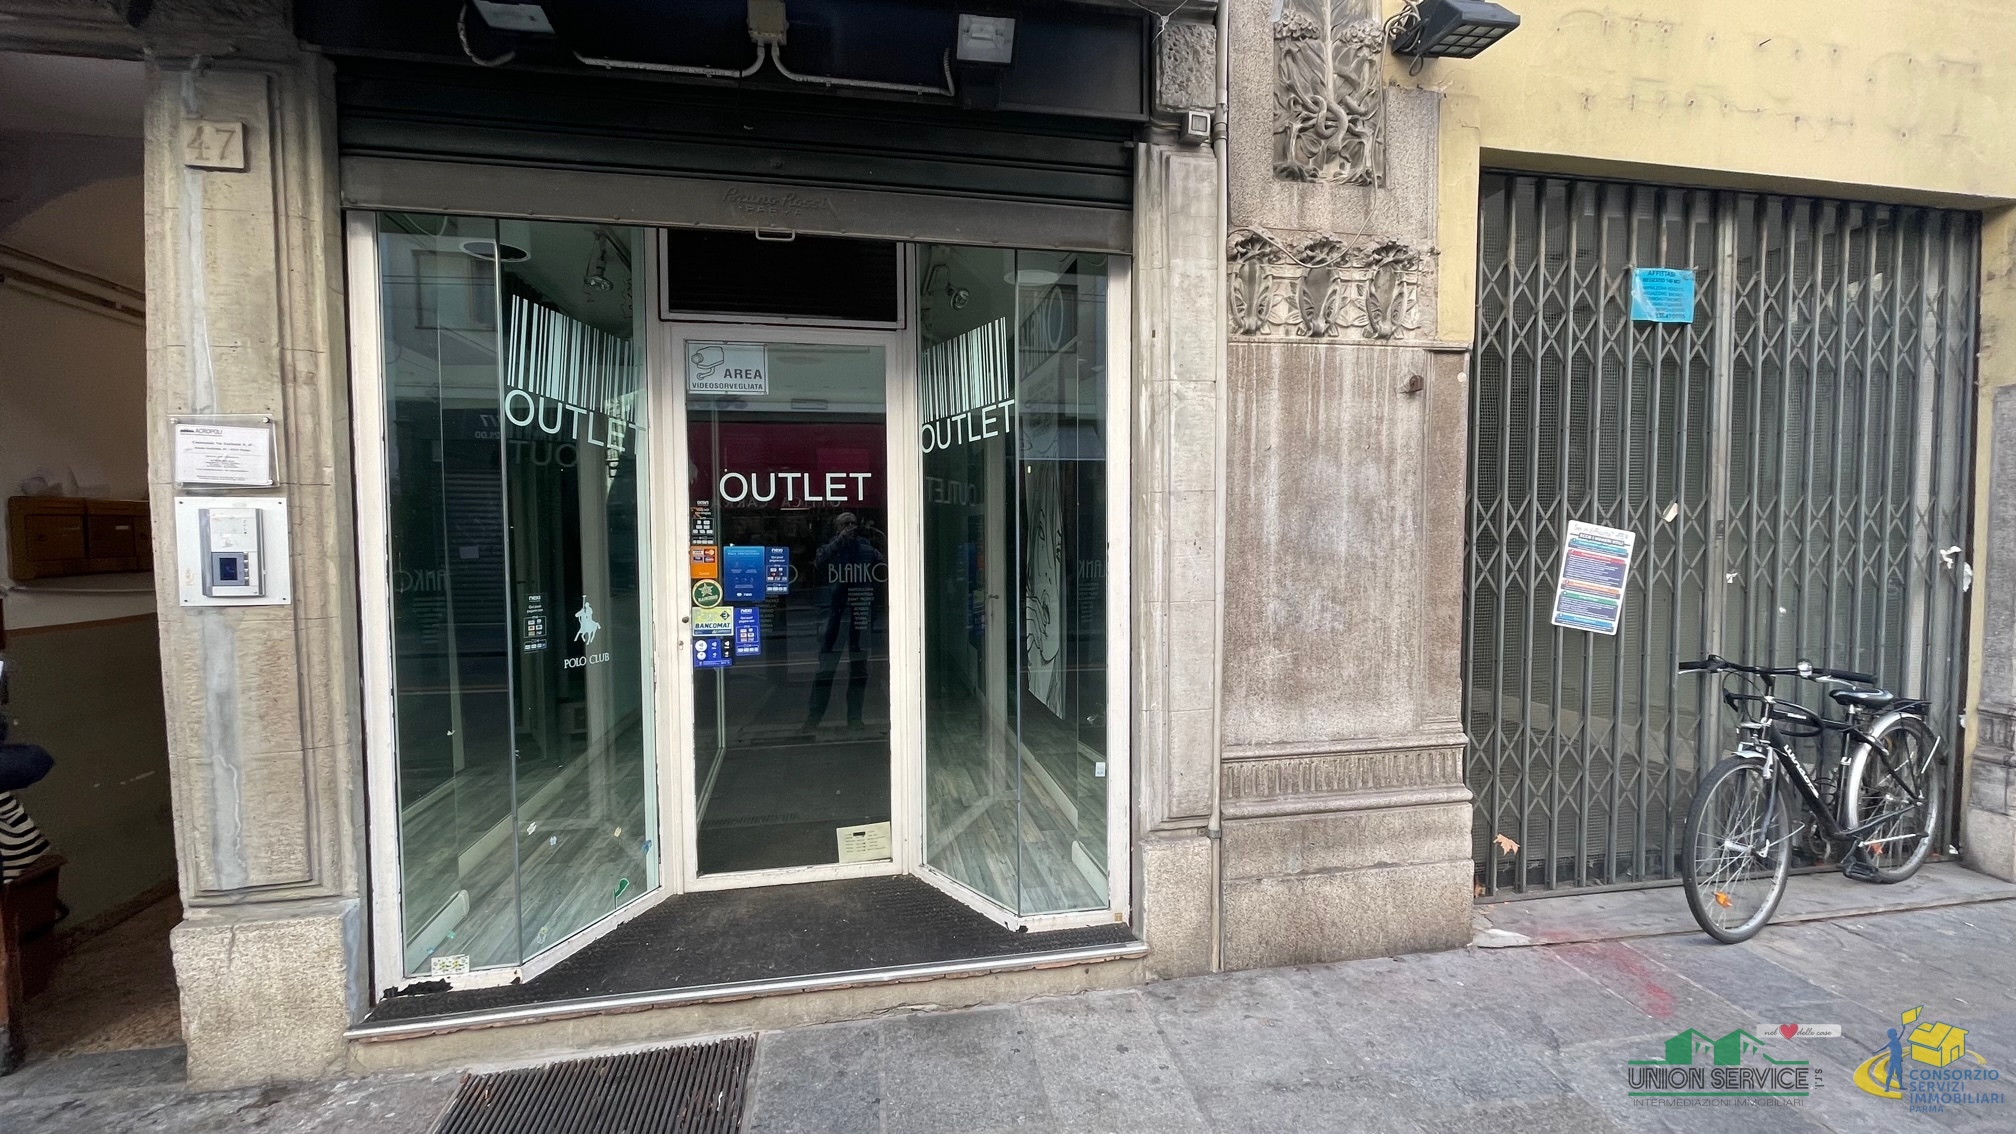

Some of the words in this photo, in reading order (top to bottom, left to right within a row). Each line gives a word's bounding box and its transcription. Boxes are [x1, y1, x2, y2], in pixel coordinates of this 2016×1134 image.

[187, 126, 236, 160] 47
[692, 382, 763, 391] VIDEOSORVEGLIATA
[723, 369, 763, 380] AREA
[505, 389, 647, 455] OUTLET
[921, 398, 1015, 454] OUTLET
[719, 472, 872, 502] OUTLET
[563, 656, 587, 670] POLO
[589, 652, 610, 665] CLUB
